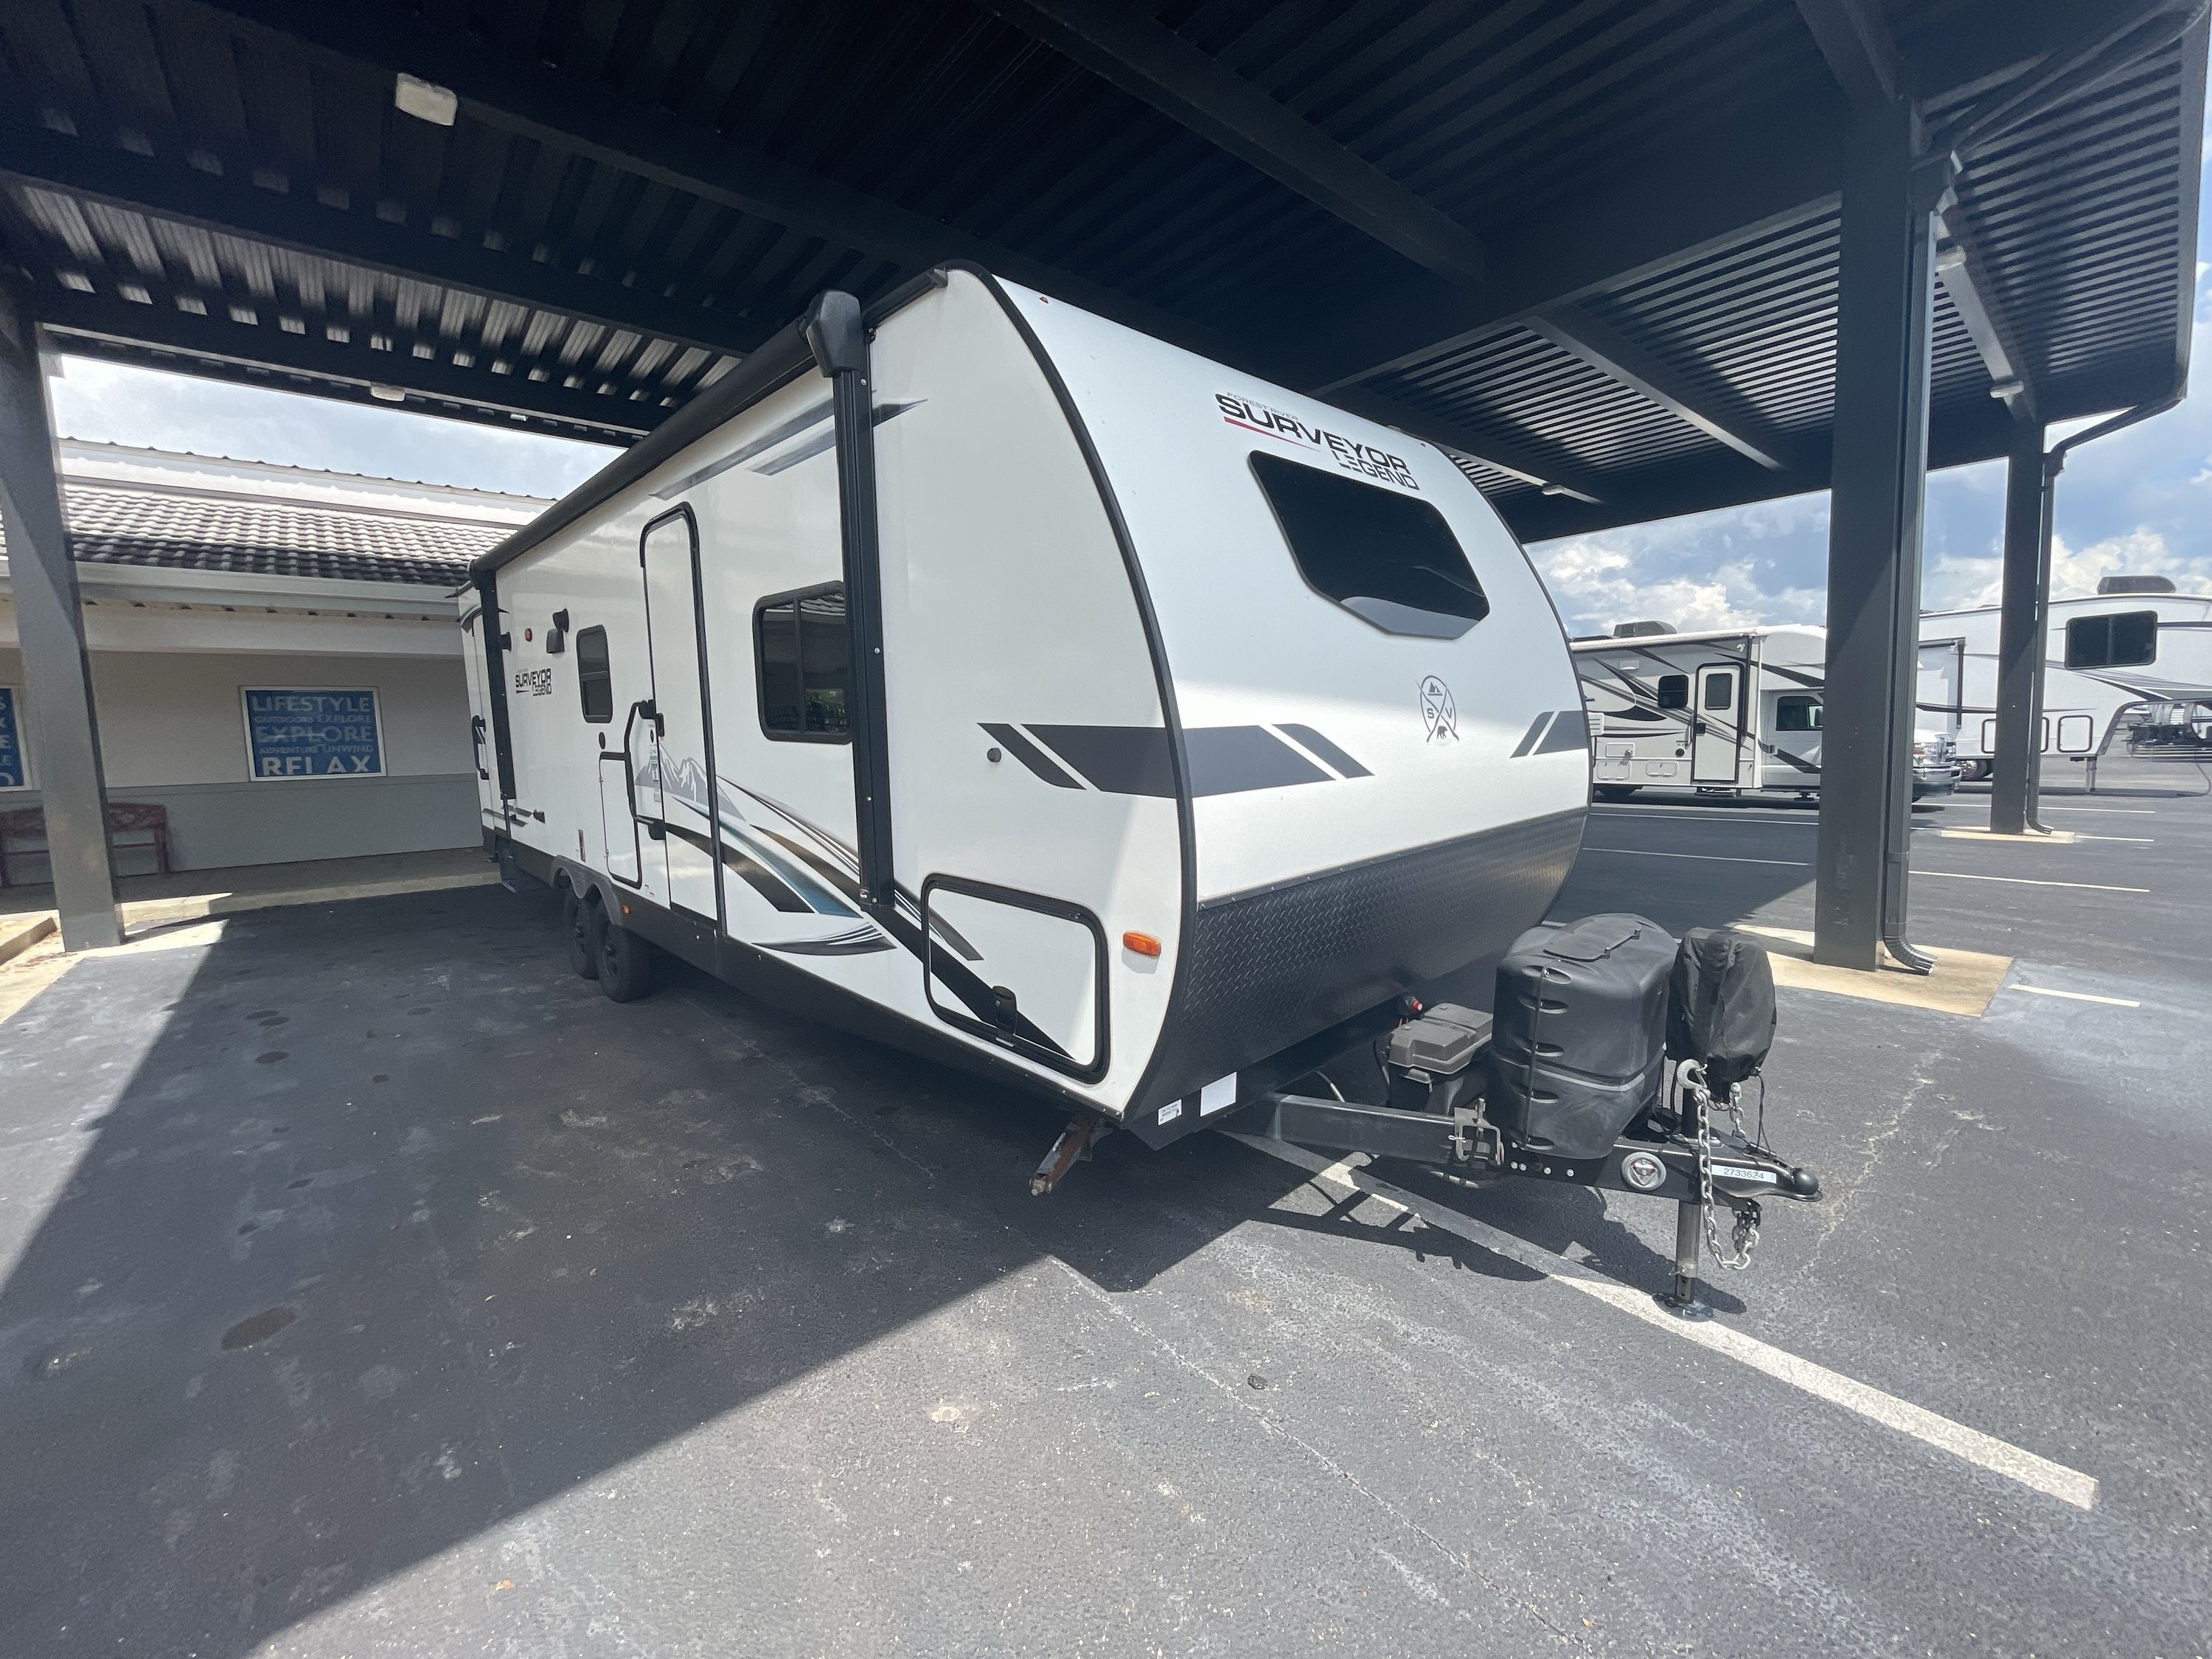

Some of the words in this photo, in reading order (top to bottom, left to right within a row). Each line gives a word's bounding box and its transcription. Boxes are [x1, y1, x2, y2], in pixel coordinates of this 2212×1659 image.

[1227, 392, 1268, 410] FOREST
[1270, 408, 1298, 420] RIVER
[1215, 394, 1411, 475] SURVEYOR
[1331, 451, 1420, 491] LEGEND
[515, 668, 552, 688] SURVEYOR
[532, 683, 552, 697] LEGEND
[252, 695, 372, 712] LIFESTYLE
[317, 714, 372, 723] EXPLORE
[256, 726, 375, 743] EXPLORE
[323, 744, 374, 753] UNWIND
[1723, 1167, 1764, 1180] 2733624
